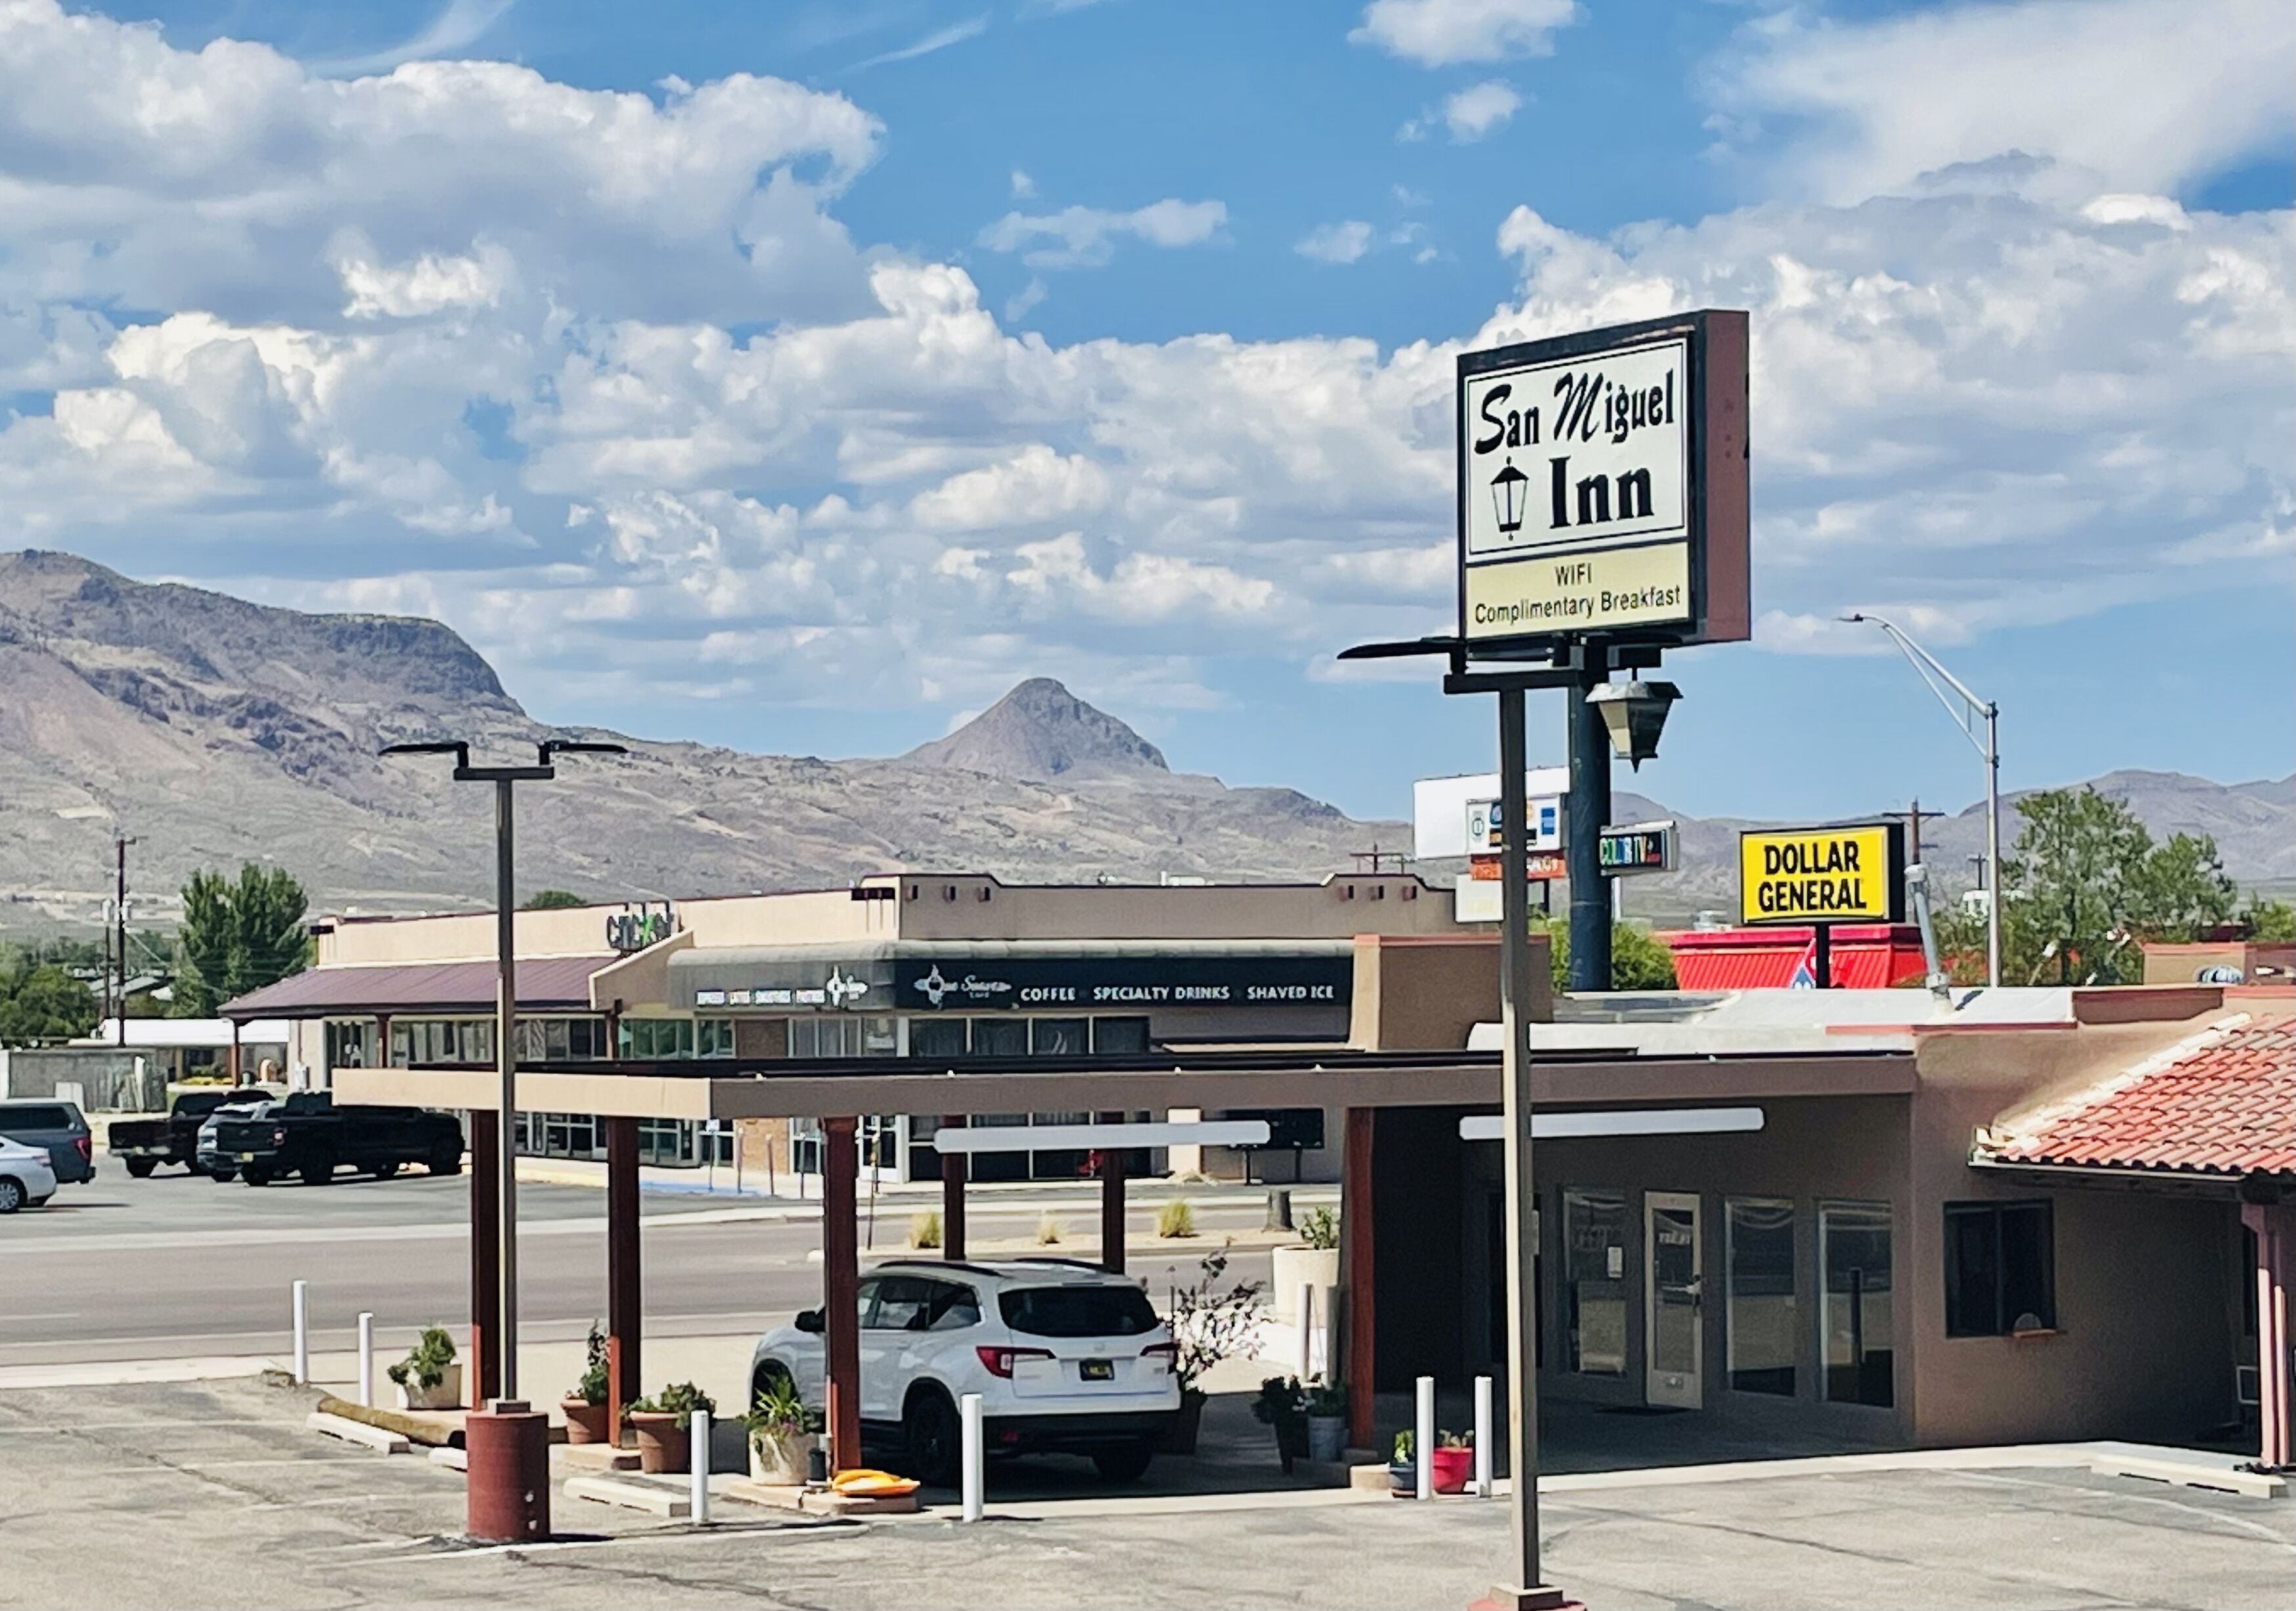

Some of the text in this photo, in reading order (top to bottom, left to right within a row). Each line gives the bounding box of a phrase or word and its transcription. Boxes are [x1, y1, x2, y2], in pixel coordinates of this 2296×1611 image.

[1474, 368, 1674, 454] San Miguel
[1549, 456, 1654, 529] Inn
[1555, 563, 1592, 587] WIFI
[1475, 585, 1680, 625] Complimentary Breakfast
[1764, 840, 1860, 875] DOLLAR
[1758, 877, 1867, 912] GENERAL
[1020, 984, 1334, 1002] COFFEE SPECIALTY DRINKS SHAVED ICE
